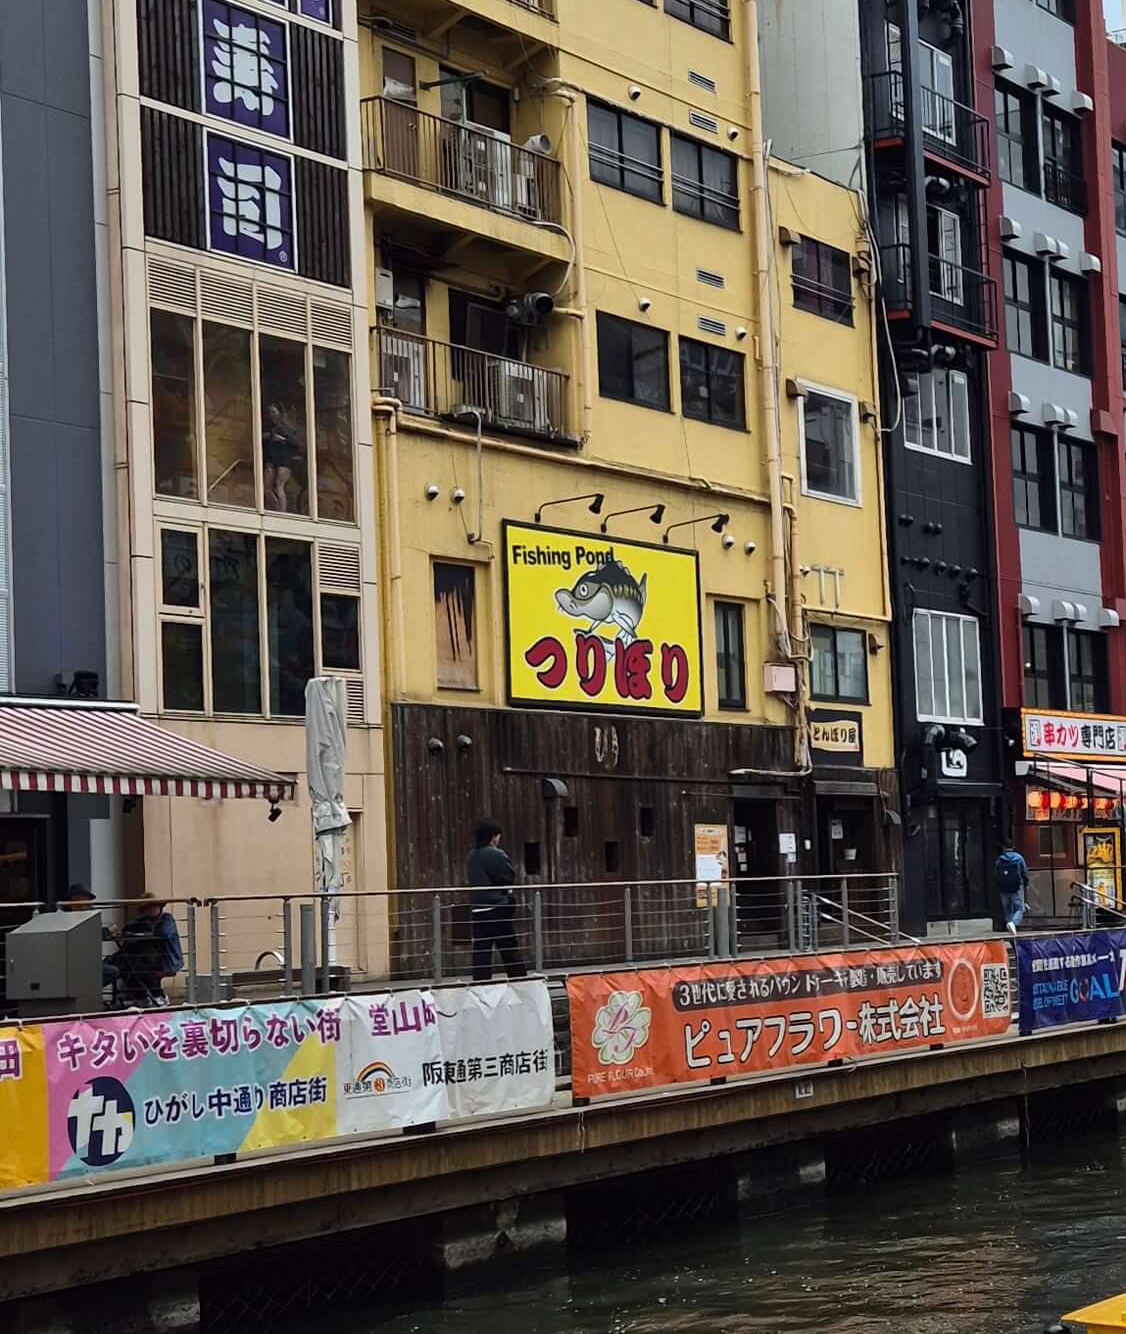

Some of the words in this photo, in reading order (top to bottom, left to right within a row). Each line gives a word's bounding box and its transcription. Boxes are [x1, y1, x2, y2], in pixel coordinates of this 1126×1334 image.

[511, 545, 572, 570] Fishing
[575, 545, 615, 566] Pond
[1043, 723, 1116, 751] 串カツ専門店
[57, 1007, 342, 1071] キタいを裏切らない街
[684, 993, 947, 1069] ピュアフラワー株式会社
[144, 1076, 328, 1125] ひがし中通り商店街
